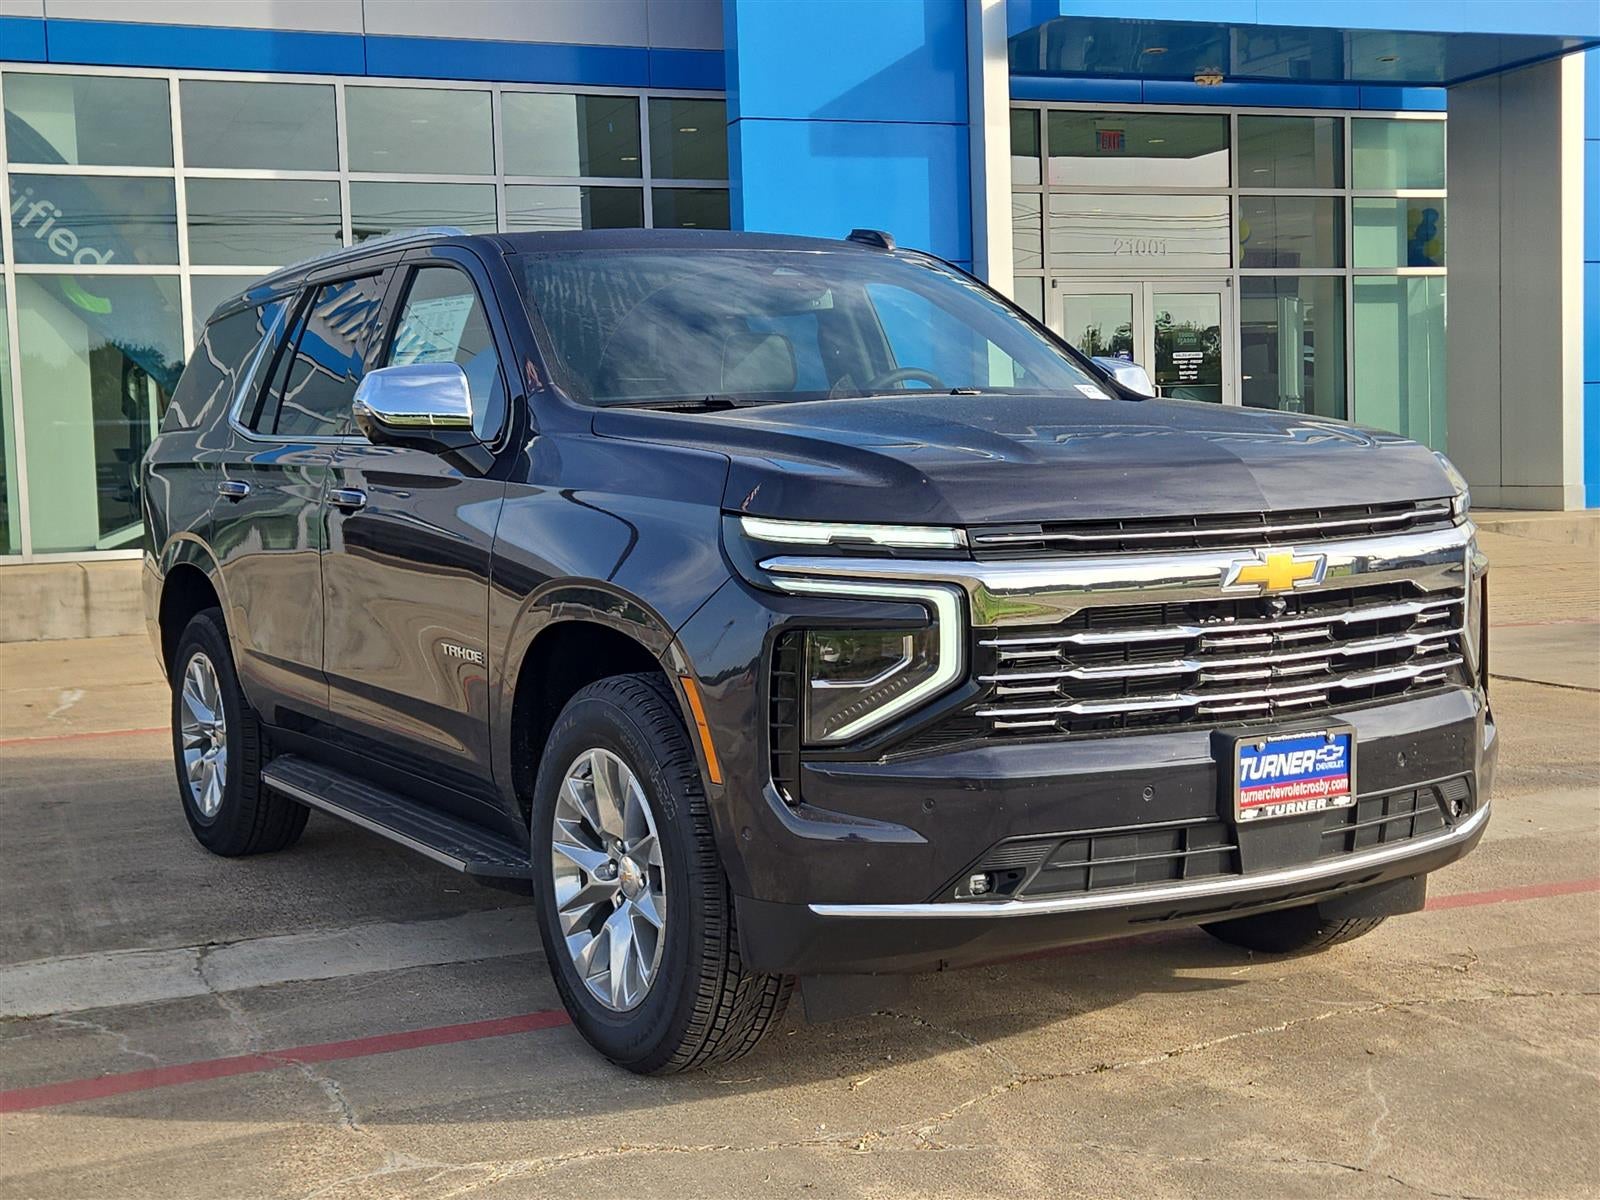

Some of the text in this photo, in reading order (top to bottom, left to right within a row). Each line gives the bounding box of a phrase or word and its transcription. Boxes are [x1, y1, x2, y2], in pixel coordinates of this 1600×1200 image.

[11, 180, 115, 265] ified
[1112, 239, 1167, 257] 21001
[440, 642, 483, 665] TAHOE
[1240, 750, 1316, 782] TURNER
[1315, 760, 1345, 771] CHEVROLET
[1240, 778, 1349, 804] turnerchevroletcrosby.com
[1265, 798, 1327, 817] TURNER
